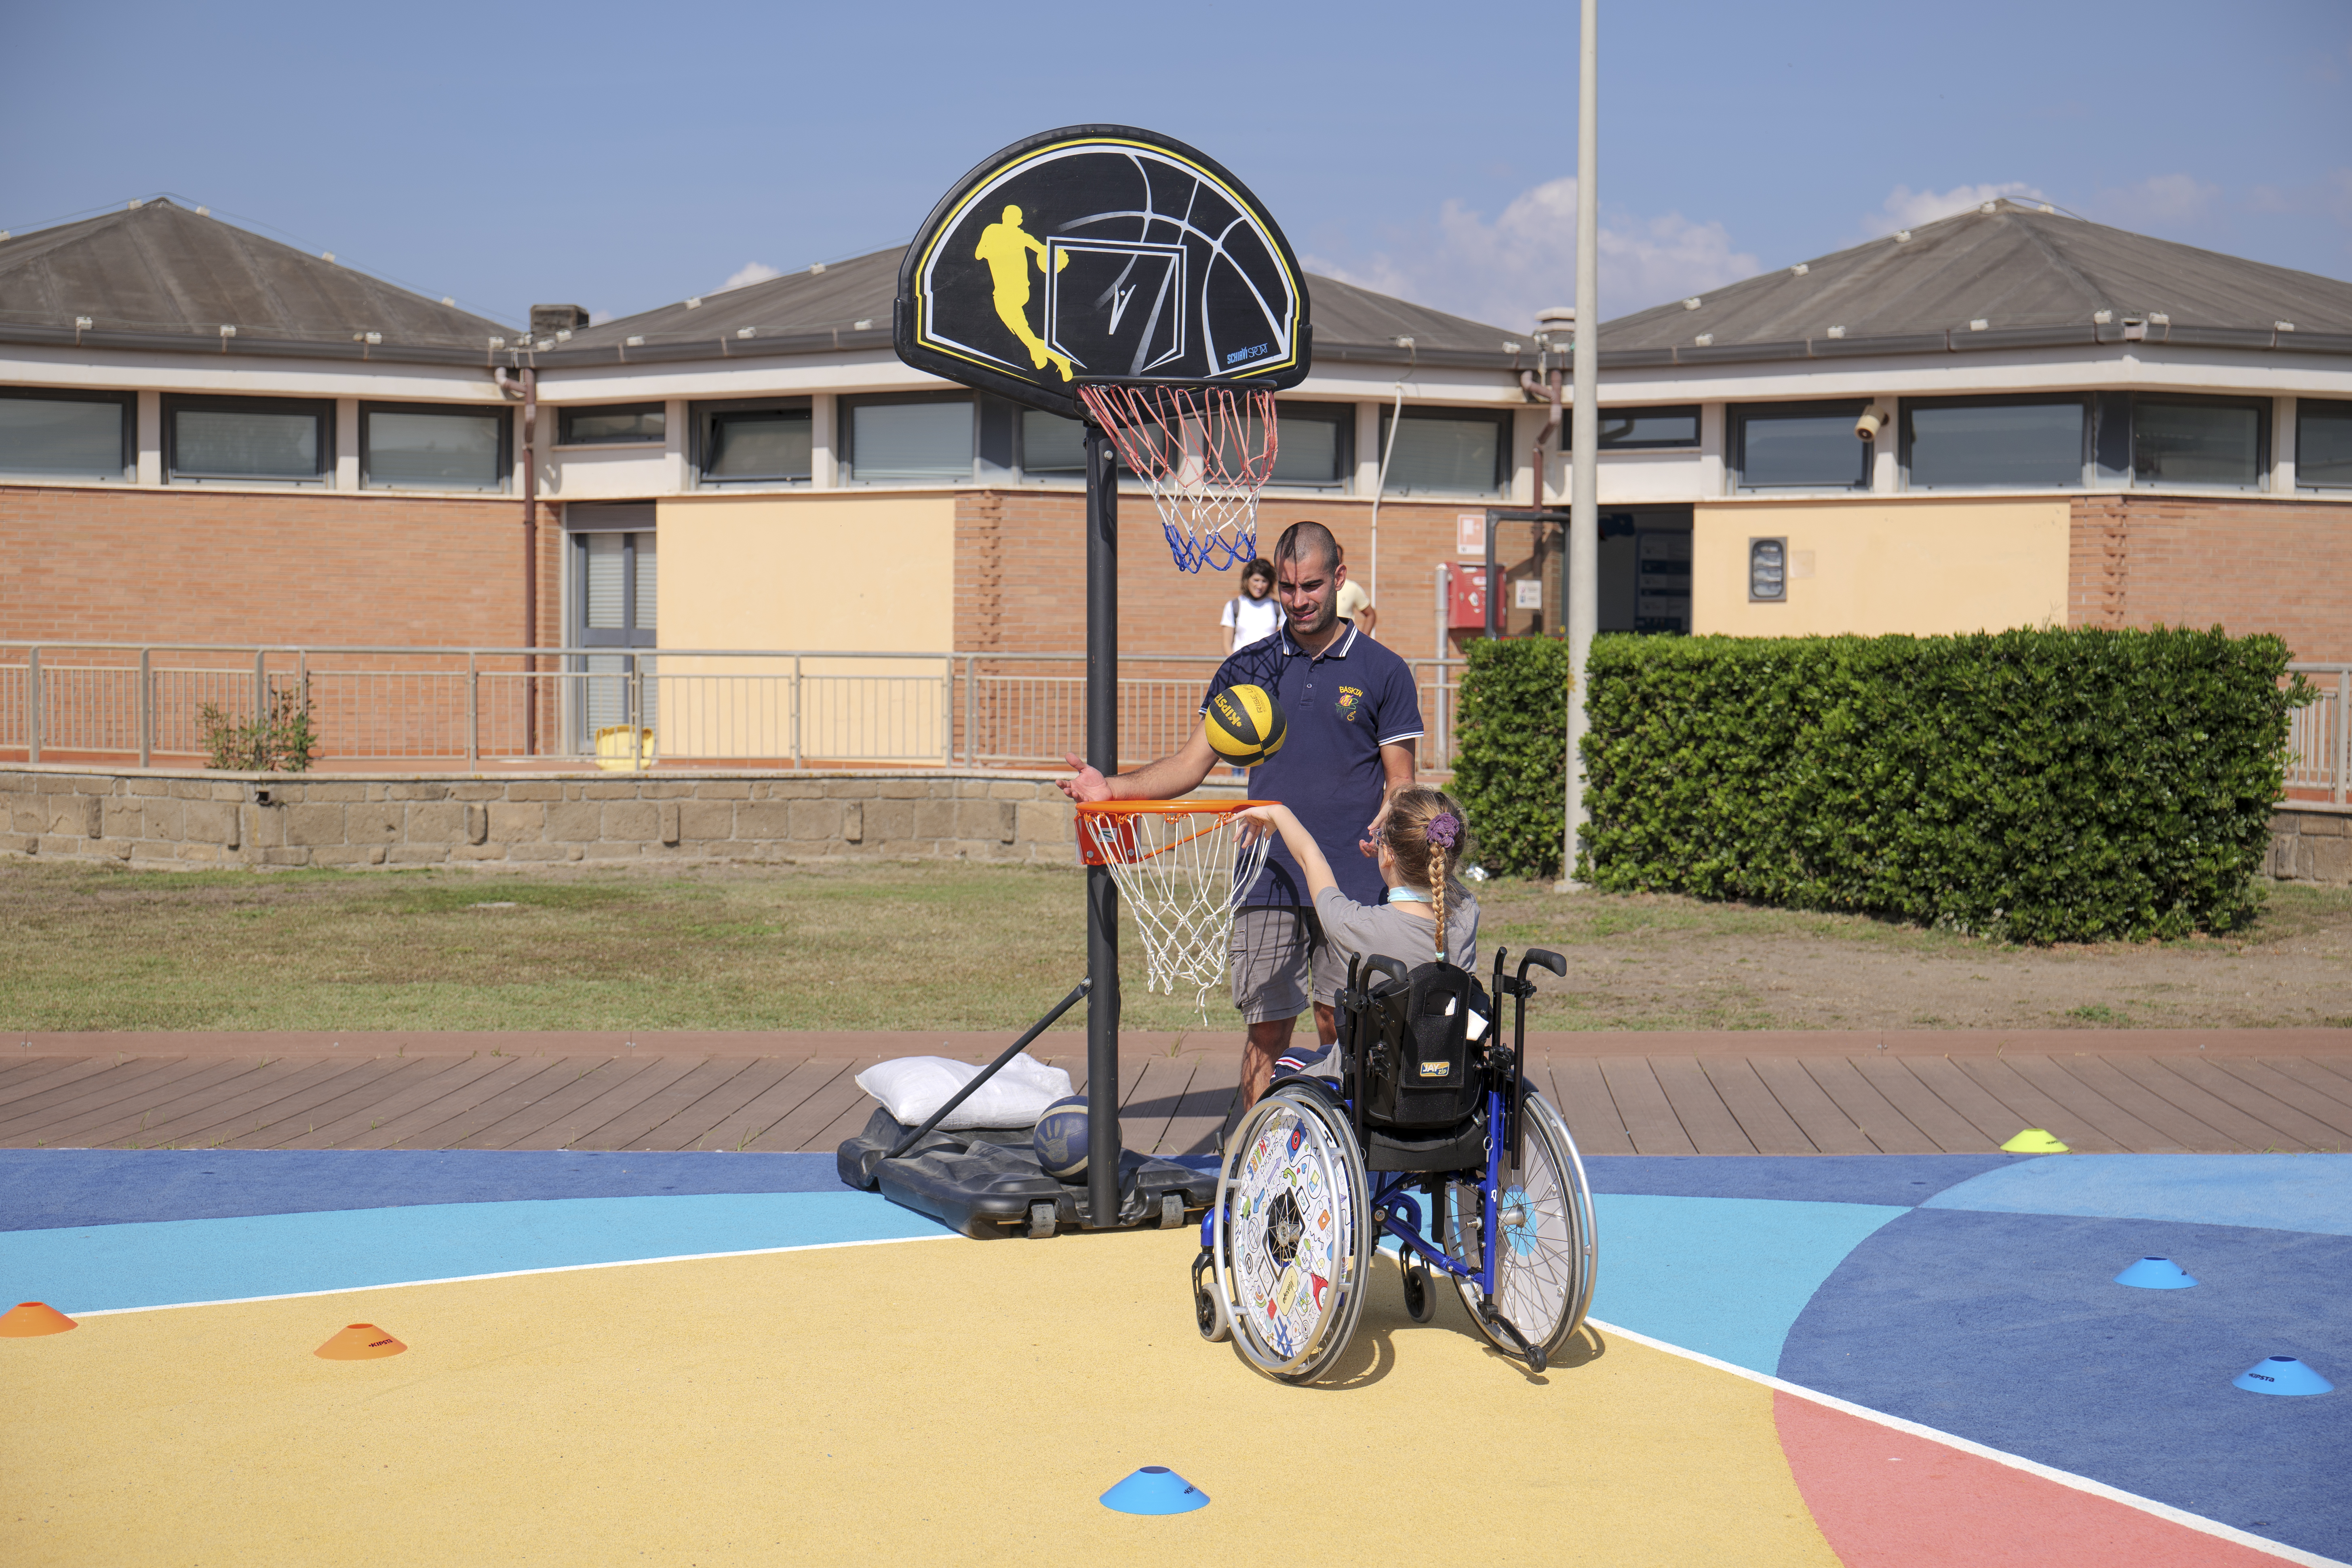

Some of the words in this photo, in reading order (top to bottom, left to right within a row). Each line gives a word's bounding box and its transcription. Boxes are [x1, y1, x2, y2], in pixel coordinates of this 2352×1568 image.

[1339, 686, 1363, 697] BASKIN
[1250, 694, 1263, 713] RISE
[1423, 1064, 1439, 1072] JAY
[1247, 1130, 1271, 1181] SHARE
[1264, 1137, 1279, 1167] SEARCH
